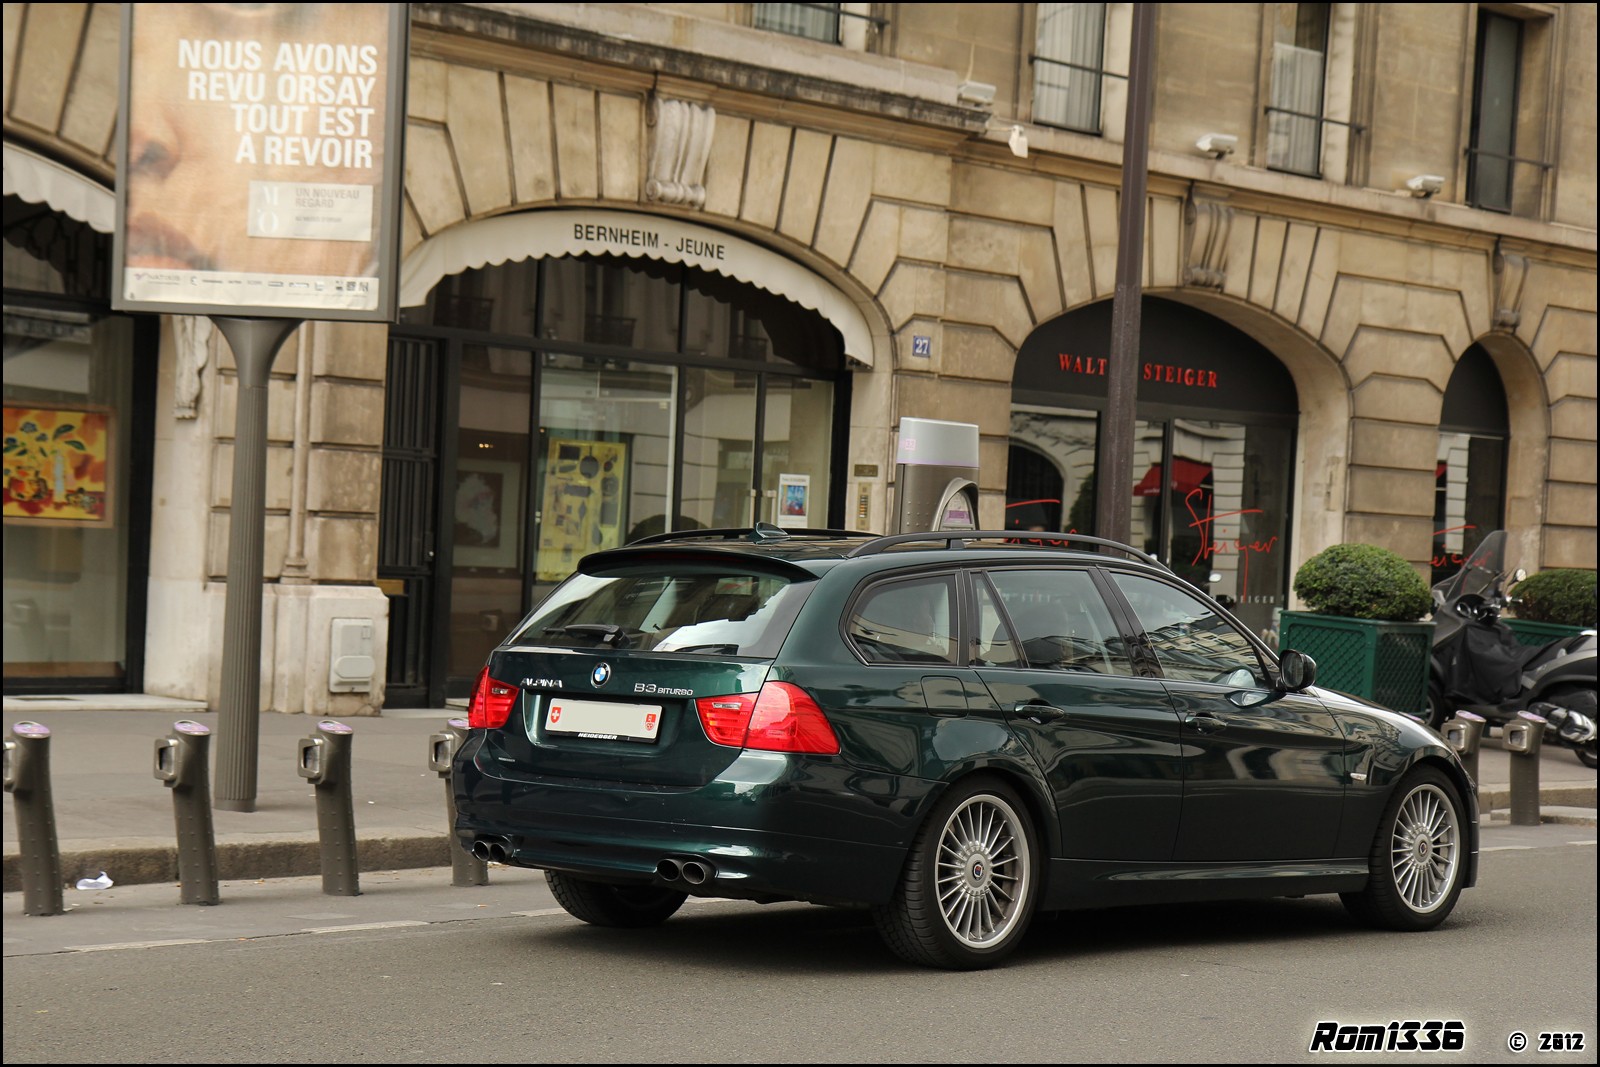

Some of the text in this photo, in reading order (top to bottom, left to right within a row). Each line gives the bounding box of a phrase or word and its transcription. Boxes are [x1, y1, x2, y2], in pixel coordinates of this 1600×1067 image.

[178, 39, 377, 75] NOUS AVONS
[188, 71, 376, 106] REVU ORSAY
[230, 103, 375, 137] TOUT EST
[264, 136, 373, 168] REVOIR
[295, 187, 360, 200] UN NOUVEAU
[295, 198, 334, 208] REGARD
[574, 223, 659, 249] BERNHEIM
[676, 237, 726, 261] JEUNE
[915, 338, 929, 354] 27
[1058, 353, 1218, 388] WALT STEIGER
[1185, 488, 1277, 600] Steiger
[519, 677, 563, 689] ALPINA
[634, 683, 694, 696] B3 BITURBO
